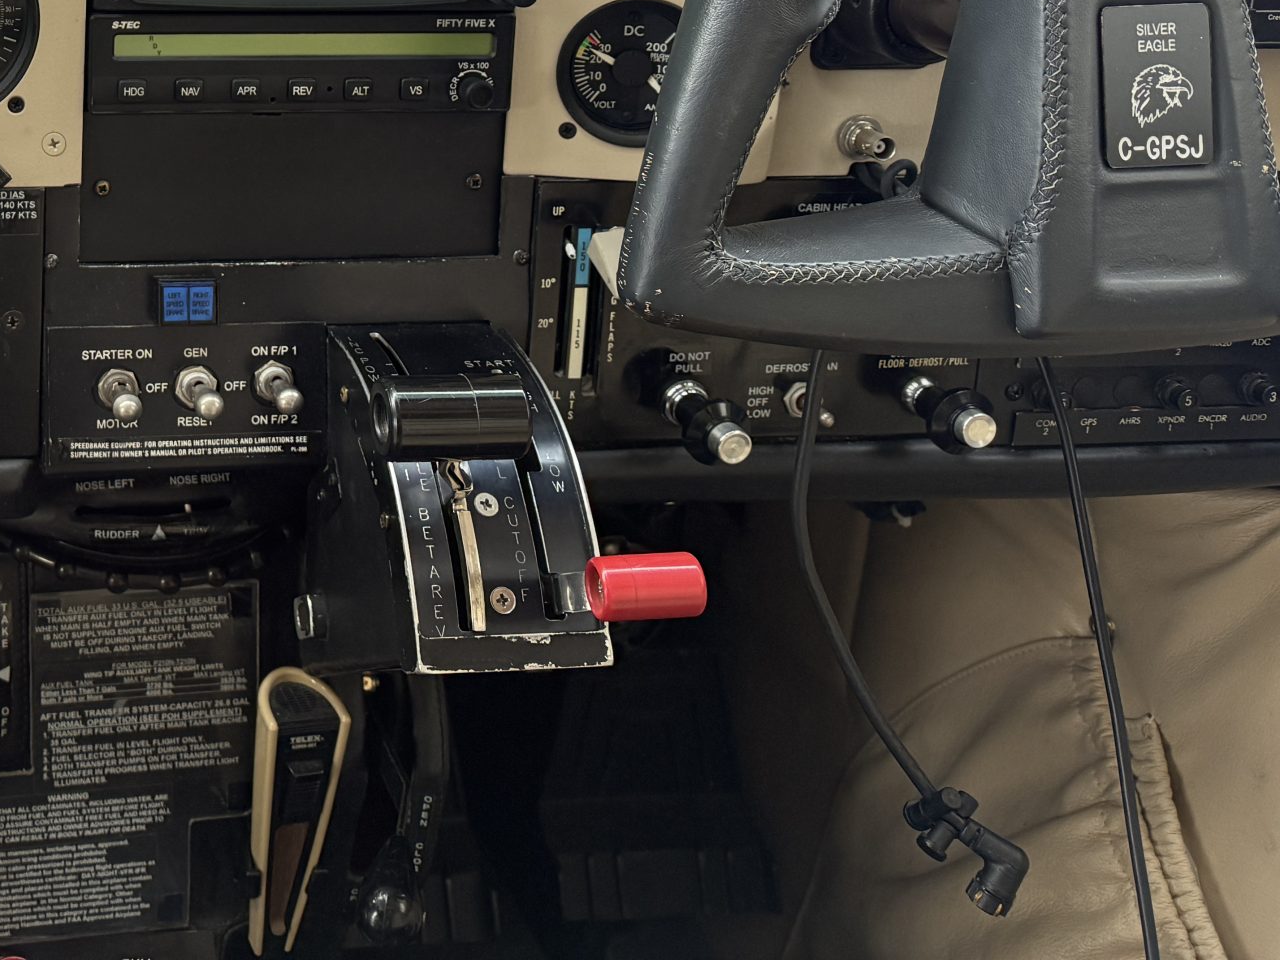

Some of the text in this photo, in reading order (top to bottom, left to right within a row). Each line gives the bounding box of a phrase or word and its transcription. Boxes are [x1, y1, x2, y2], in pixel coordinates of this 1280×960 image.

[112, 21, 140, 30] S-TEC
[436, 18, 496, 28] FIFTY FIVE X
[1136, 23, 1176, 36] SILVER
[1138, 39, 1176, 52] EAGLE
[123, 86, 145, 97] HDG
[181, 86, 200, 97] NAV
[237, 85, 257, 96] APR
[292, 85, 313, 96] REV
[352, 85, 370, 96] ALT
[409, 85, 423, 96] VS
[1118, 134, 1204, 161] C-GPSJ
[82, 349, 152, 360] STARTER ON
[184, 348, 208, 358] GEN
[251, 346, 297, 356] ON F/P 1
